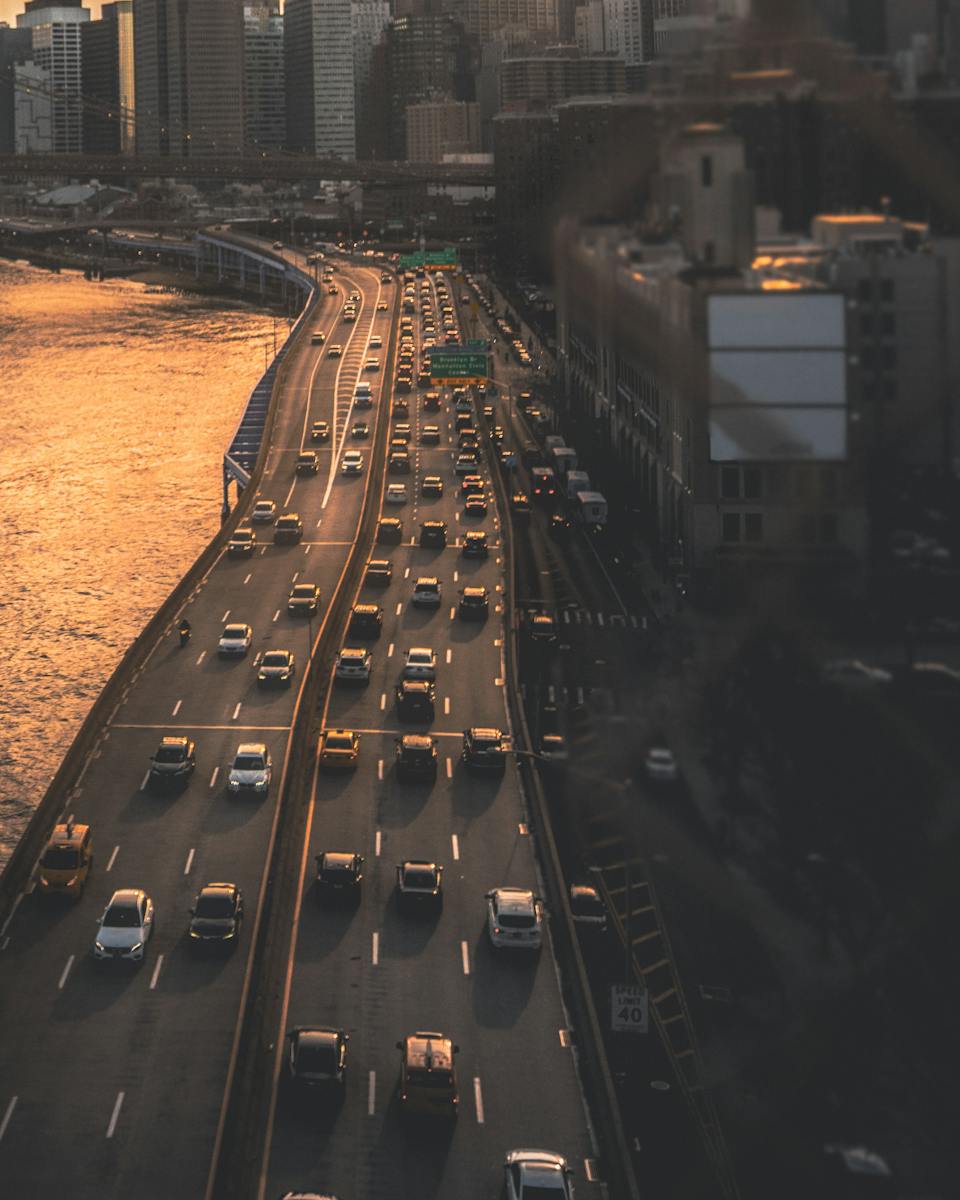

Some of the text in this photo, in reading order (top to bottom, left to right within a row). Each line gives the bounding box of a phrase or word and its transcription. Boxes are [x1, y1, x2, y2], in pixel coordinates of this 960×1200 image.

[615, 986, 645, 996] SPEED
[618, 997, 641, 1006] LIMIT
[617, 1006, 642, 1023] 40
